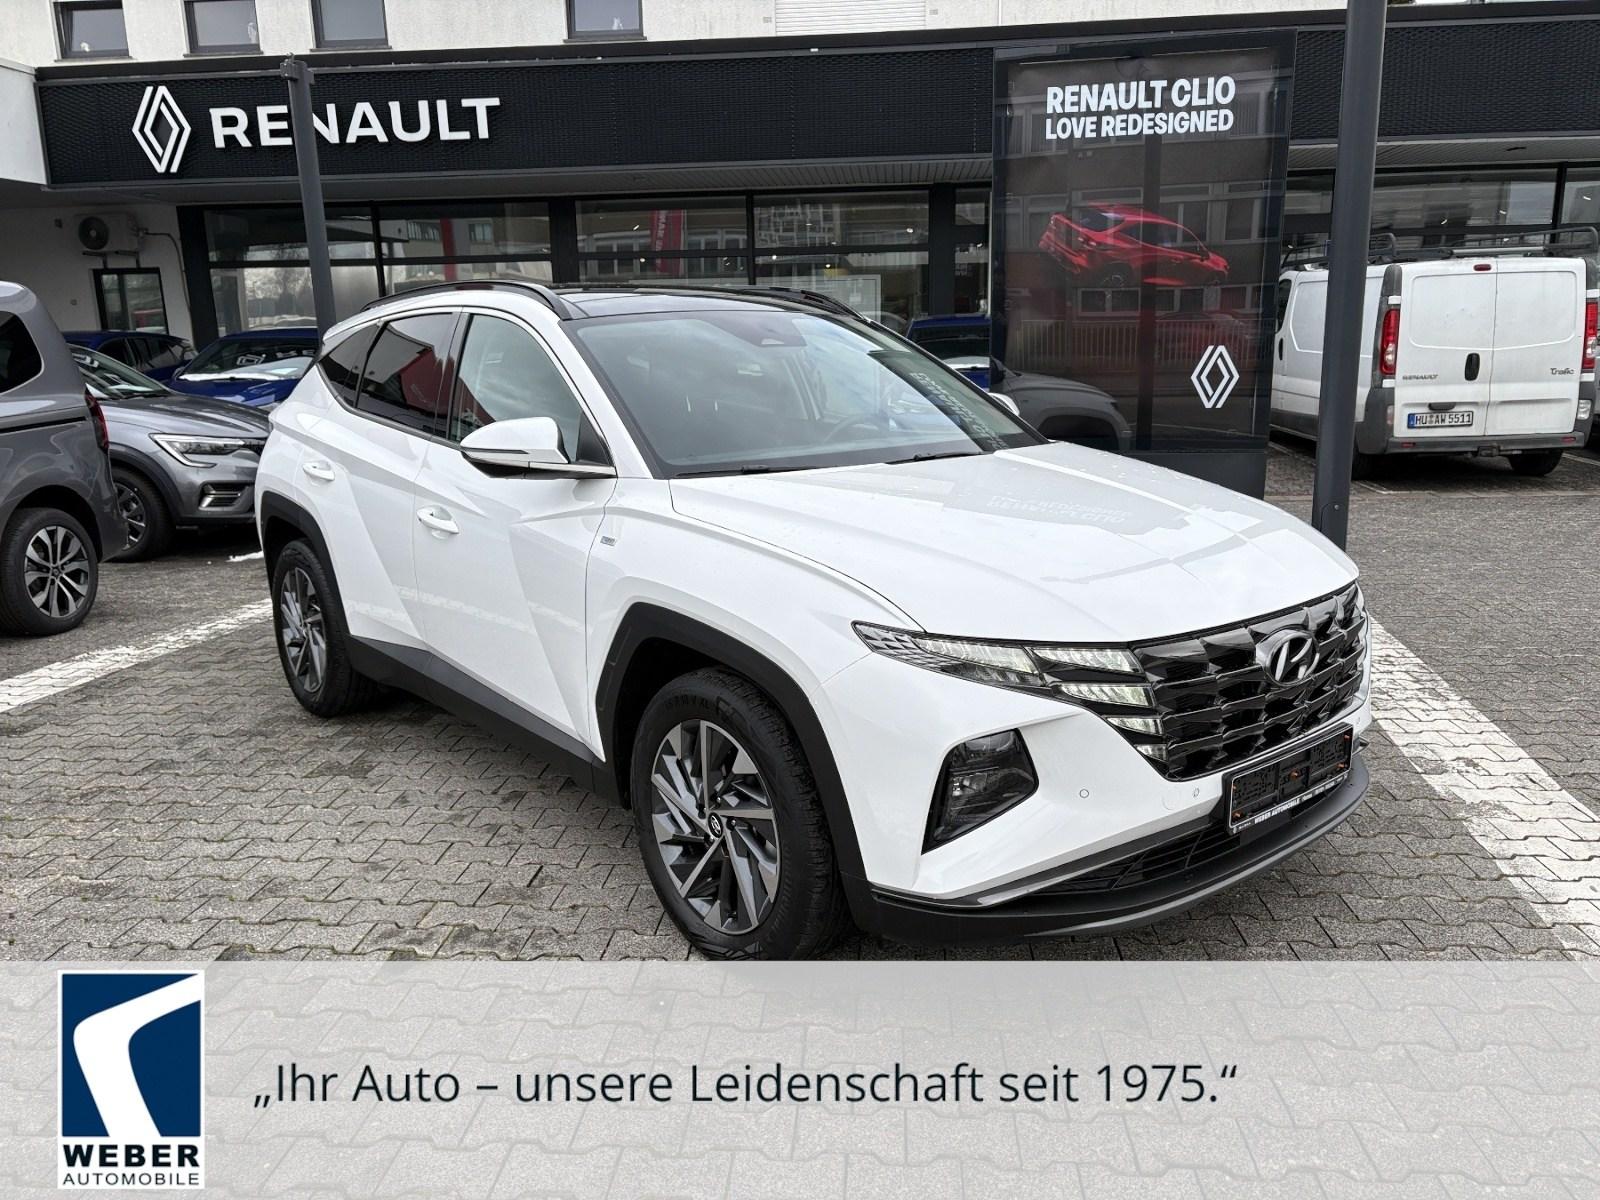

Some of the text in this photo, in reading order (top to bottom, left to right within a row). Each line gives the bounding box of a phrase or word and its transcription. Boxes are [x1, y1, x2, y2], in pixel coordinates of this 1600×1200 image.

[1046, 75, 1236, 114] RENAULT CLIO
[209, 97, 500, 148] RENAULT
[1045, 108, 1234, 140] LOVE REDESIGNED
[1448, 413, 1471, 424] 5511
